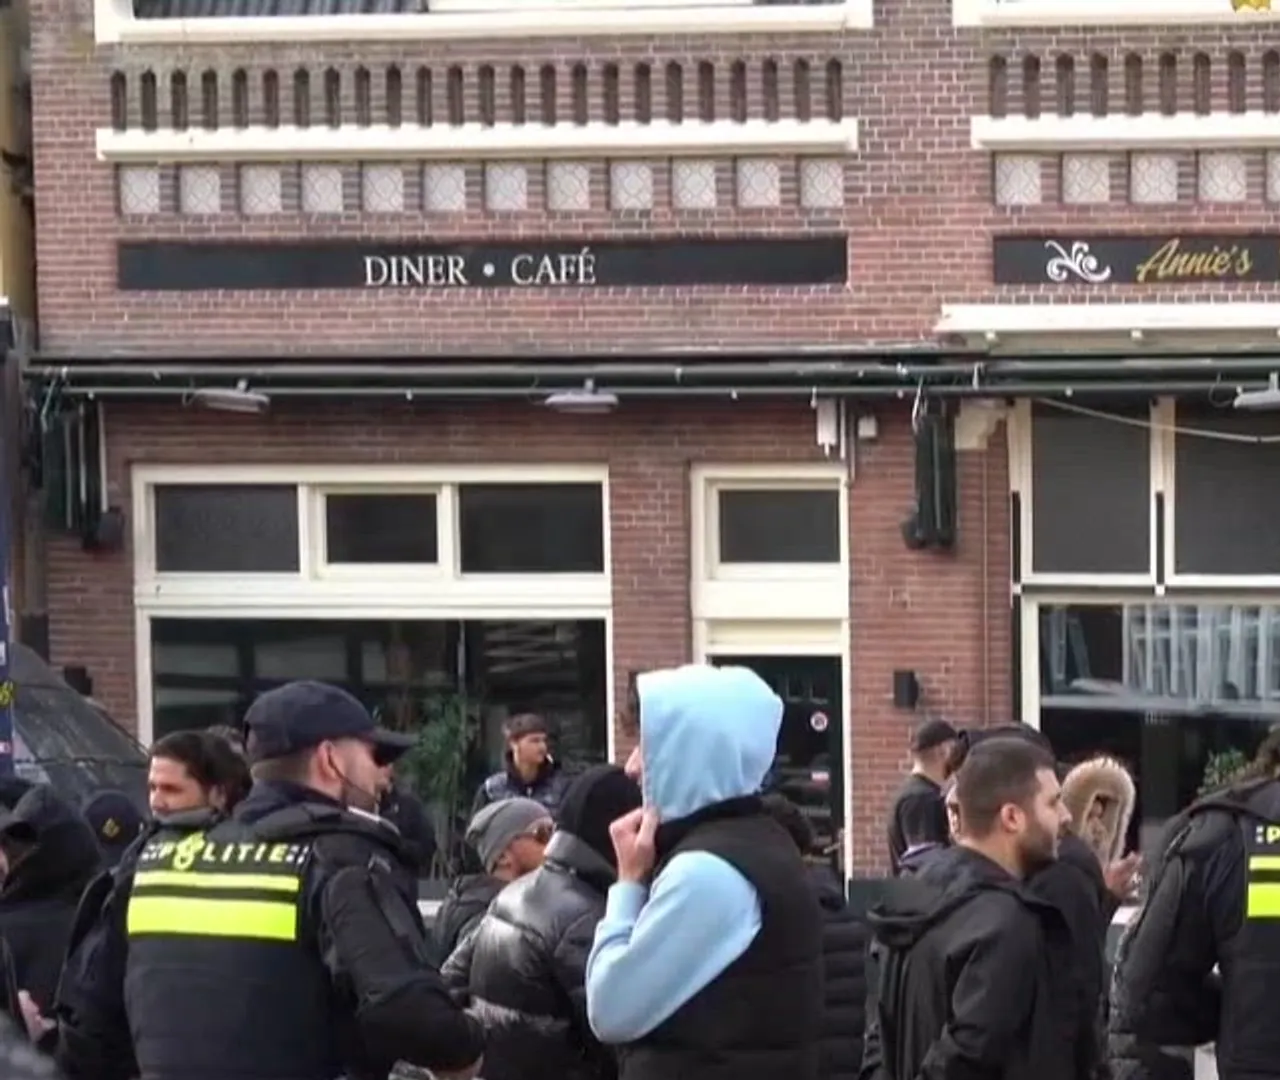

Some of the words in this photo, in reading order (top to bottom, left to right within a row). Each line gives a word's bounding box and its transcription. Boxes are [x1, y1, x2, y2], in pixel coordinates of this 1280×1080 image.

[363, 255, 468, 286] DINER
[511, 246, 597, 285] CAFÉ
[1136, 237, 1252, 282] Annie's
[158, 831, 289, 870] POLITIE
